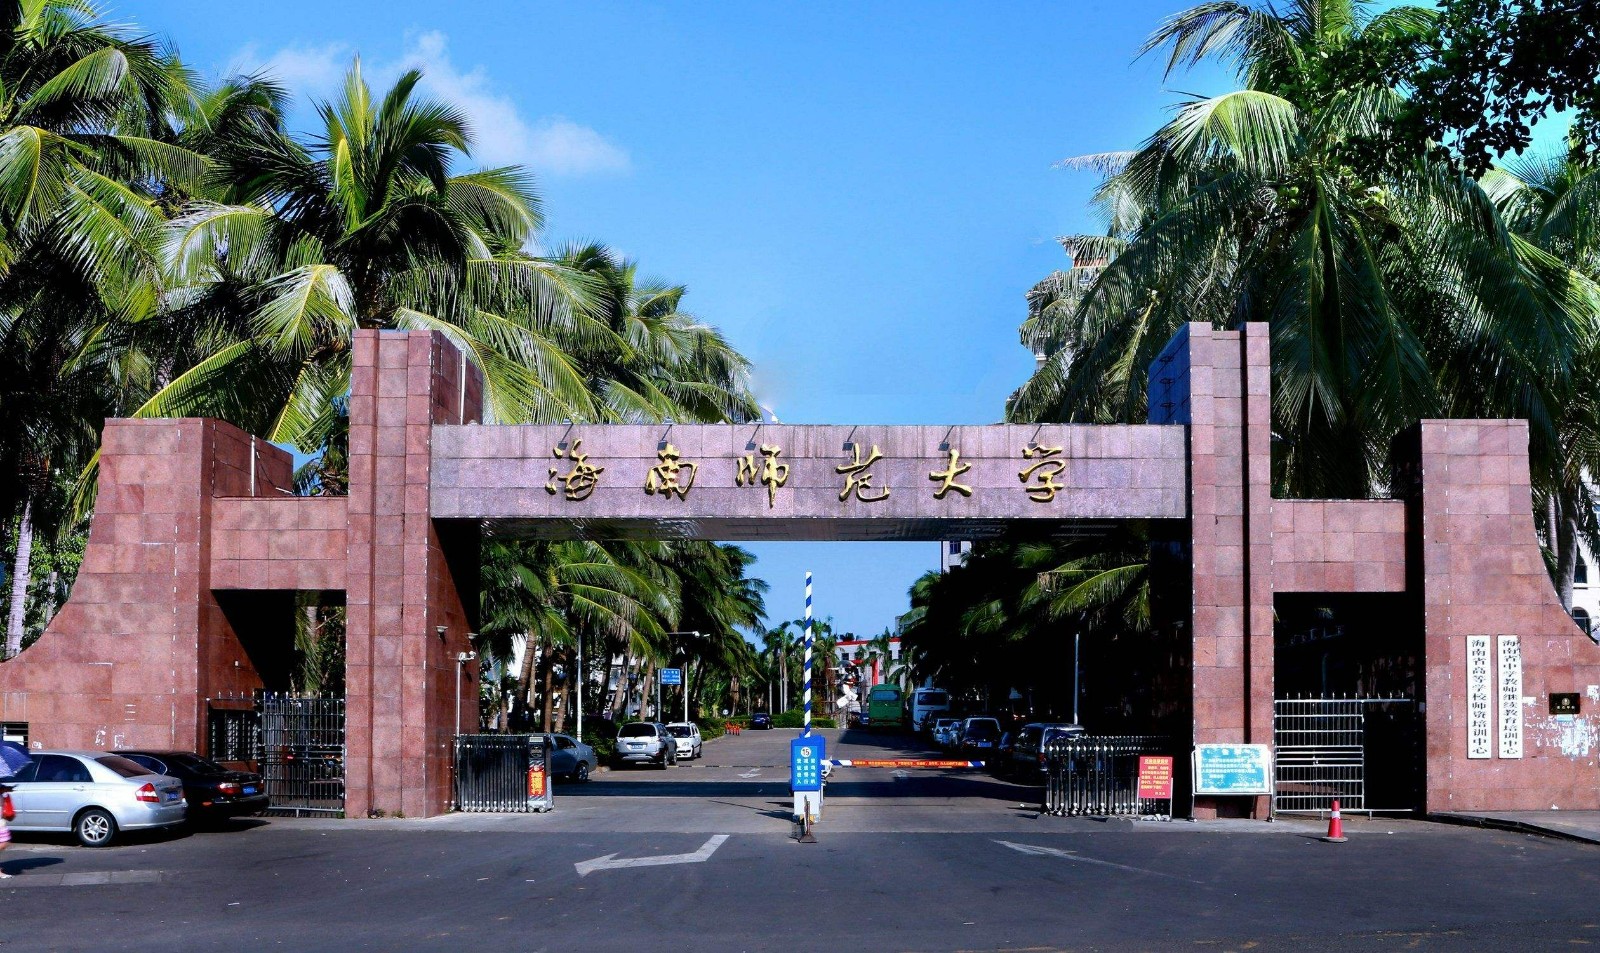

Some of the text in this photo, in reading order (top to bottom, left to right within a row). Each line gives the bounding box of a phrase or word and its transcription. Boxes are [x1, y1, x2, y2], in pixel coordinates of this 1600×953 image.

[544, 439, 1068, 509] 海南师范大学
[1472, 639, 1488, 755] 海南省高等学校师资培训中心
[1502, 639, 1518, 755] 海南省中学教师继续教育培训中心
[802, 748, 810, 756] 15
